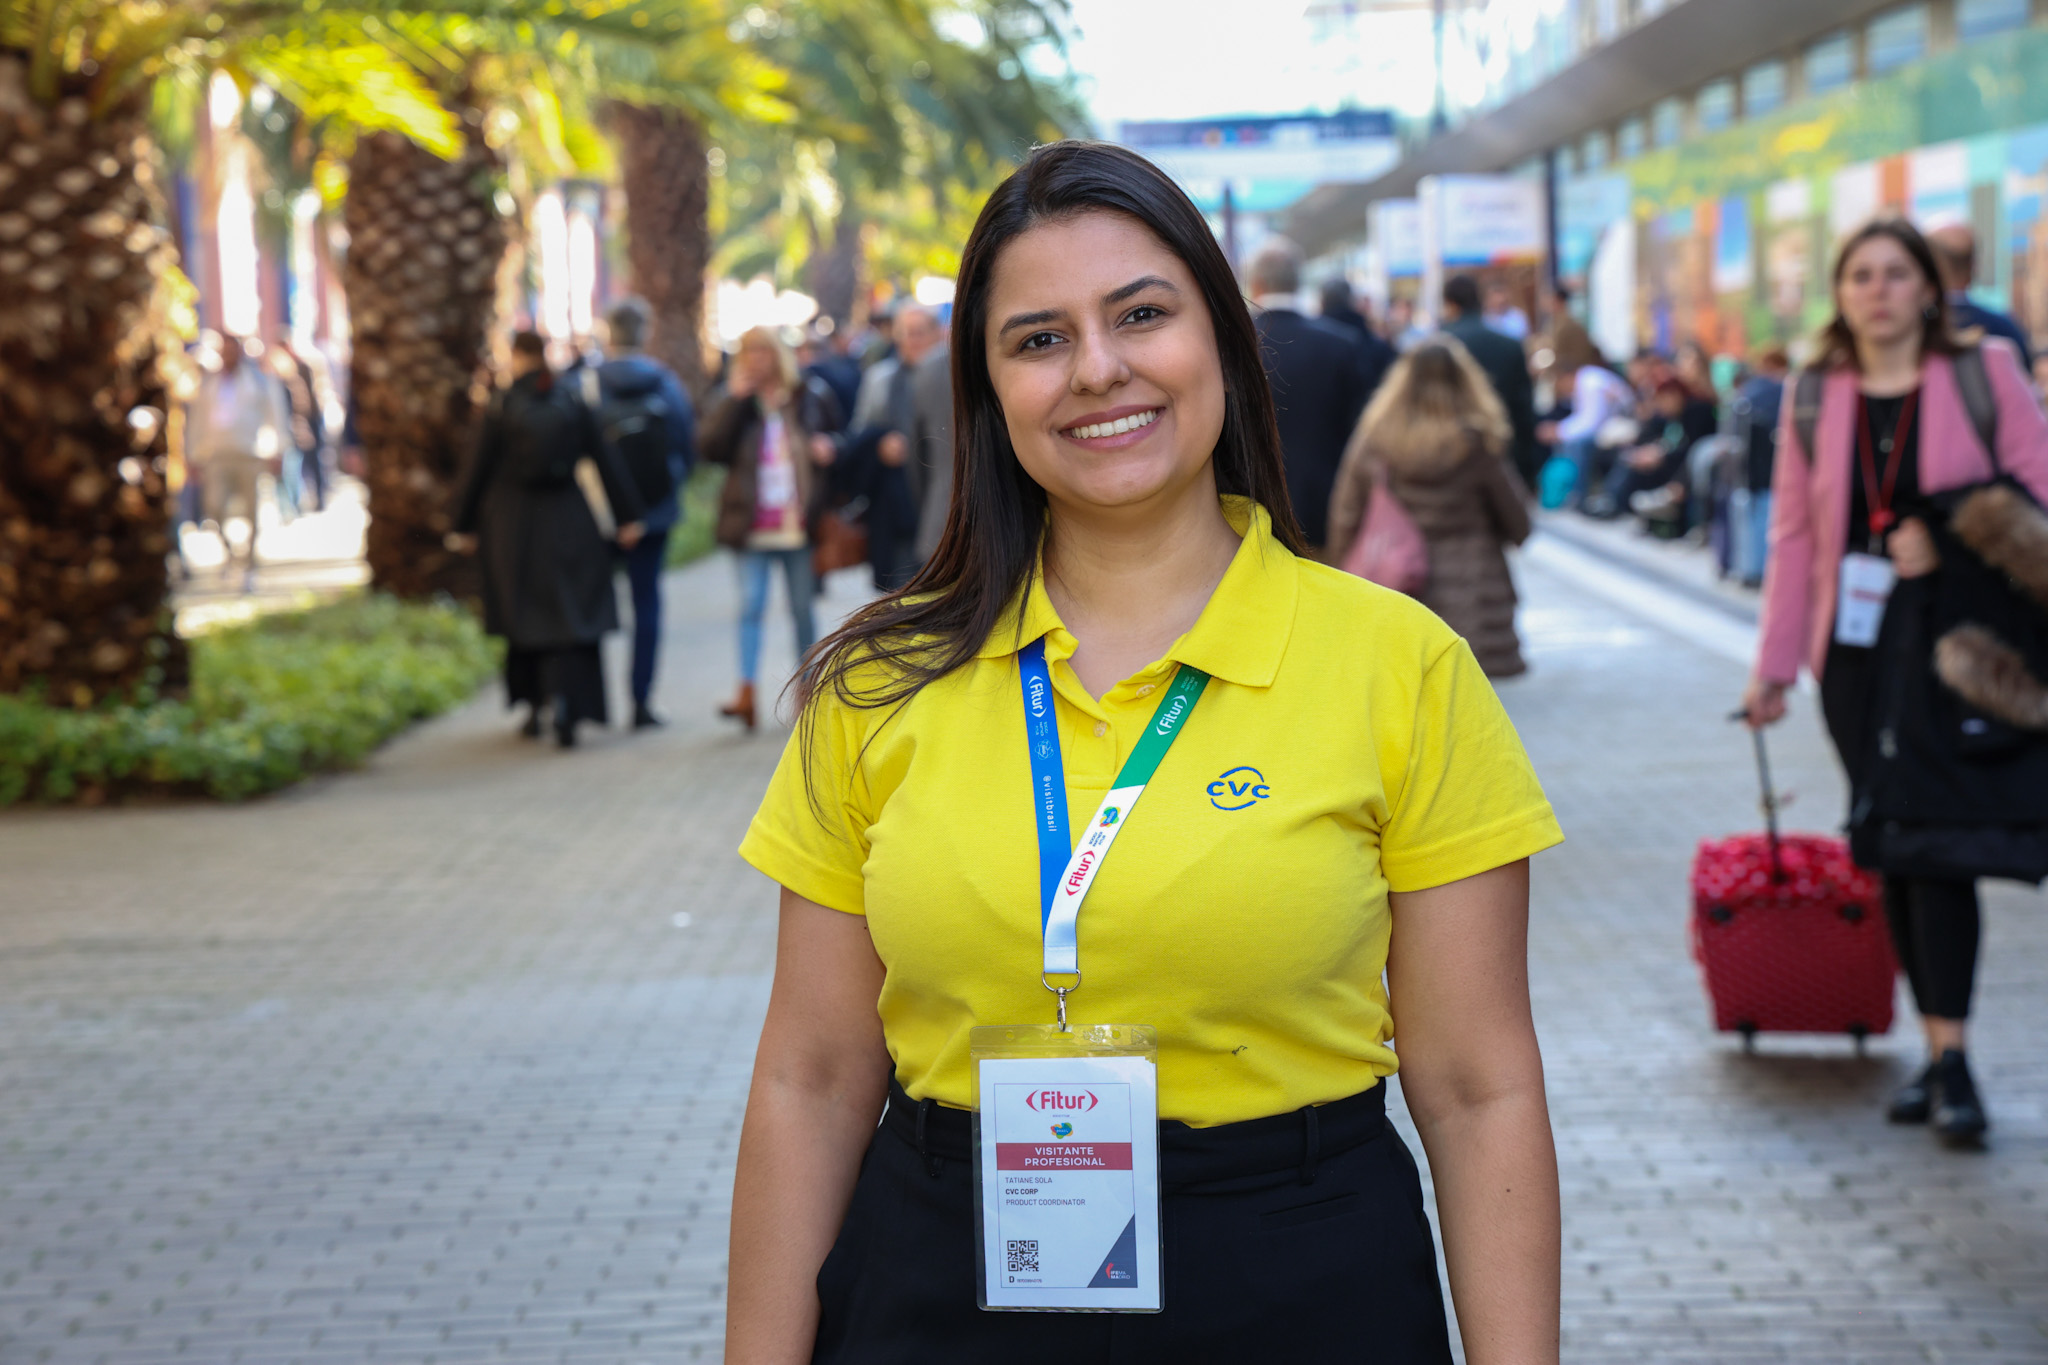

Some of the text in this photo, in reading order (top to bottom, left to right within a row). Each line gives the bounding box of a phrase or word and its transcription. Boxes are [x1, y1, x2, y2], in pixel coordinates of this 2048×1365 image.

[1030, 683, 1044, 710] Fitur
[1159, 701, 1183, 729] Fitur
[1207, 781, 1270, 798] CVC
[1043, 775, 1057, 831] @visitbrasil
[1068, 857, 1092, 887] Fitur
[1041, 1091, 1085, 1109] Fitur
[1024, 1158, 1106, 1166] PROFESIONAL
[1035, 1147, 1094, 1155] VISITANTE
